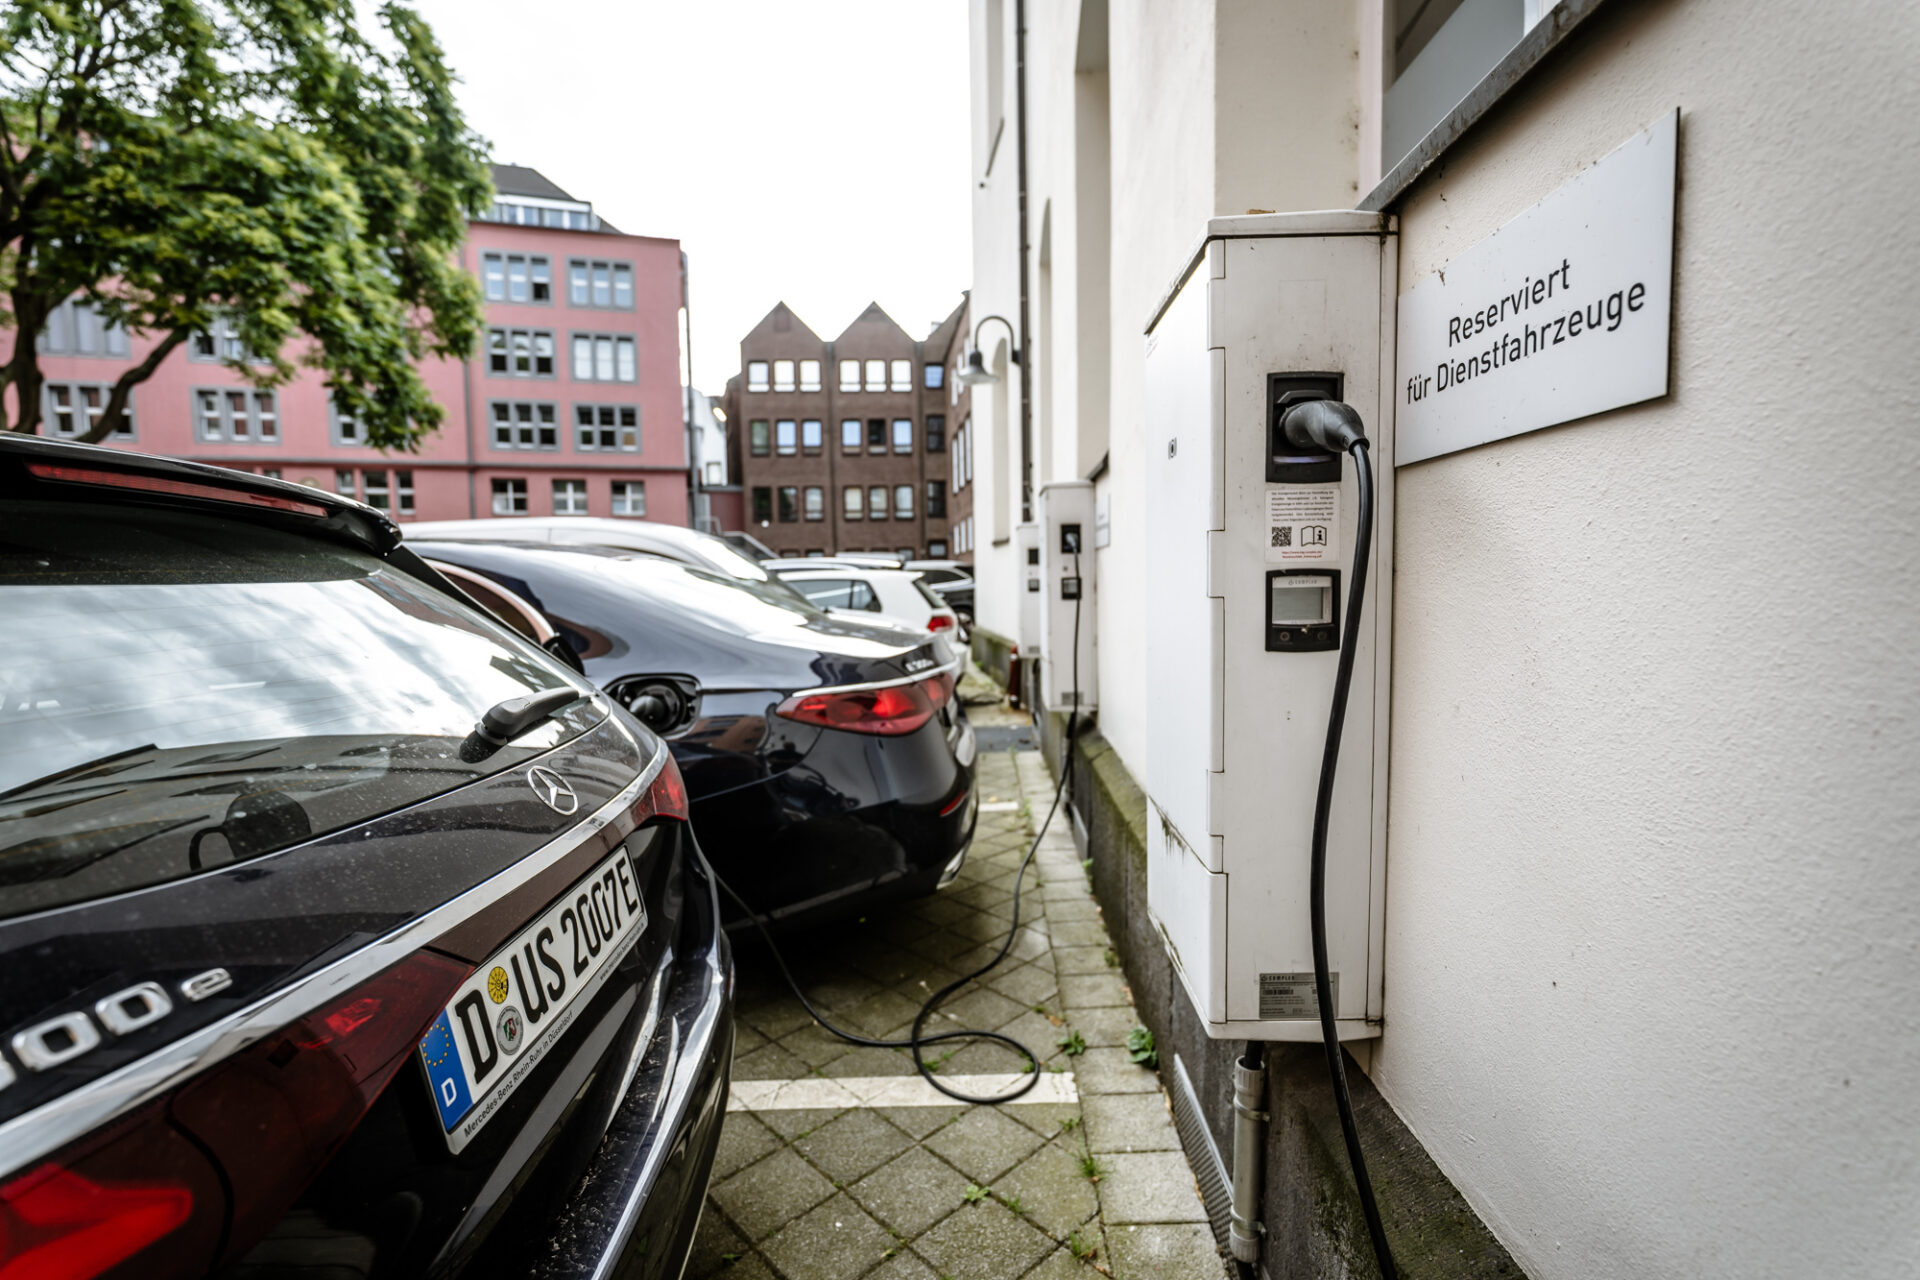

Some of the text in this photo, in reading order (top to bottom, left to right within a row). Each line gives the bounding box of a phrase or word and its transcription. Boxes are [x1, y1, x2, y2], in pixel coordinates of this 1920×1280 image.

[1406, 281, 1646, 405] für Dienstfahrzeuge
[1448, 258, 1570, 348] Reserviert
[456, 857, 638, 1085] D US 2007E
[0, 981, 174, 1092] 00
[441, 1076, 458, 1108] D
[464, 1080, 514, 1137] Mercedes-Benz
[512, 1046, 544, 1083] Rhein-Ruhr
[548, 1009, 574, 1046] Düsseldorf
